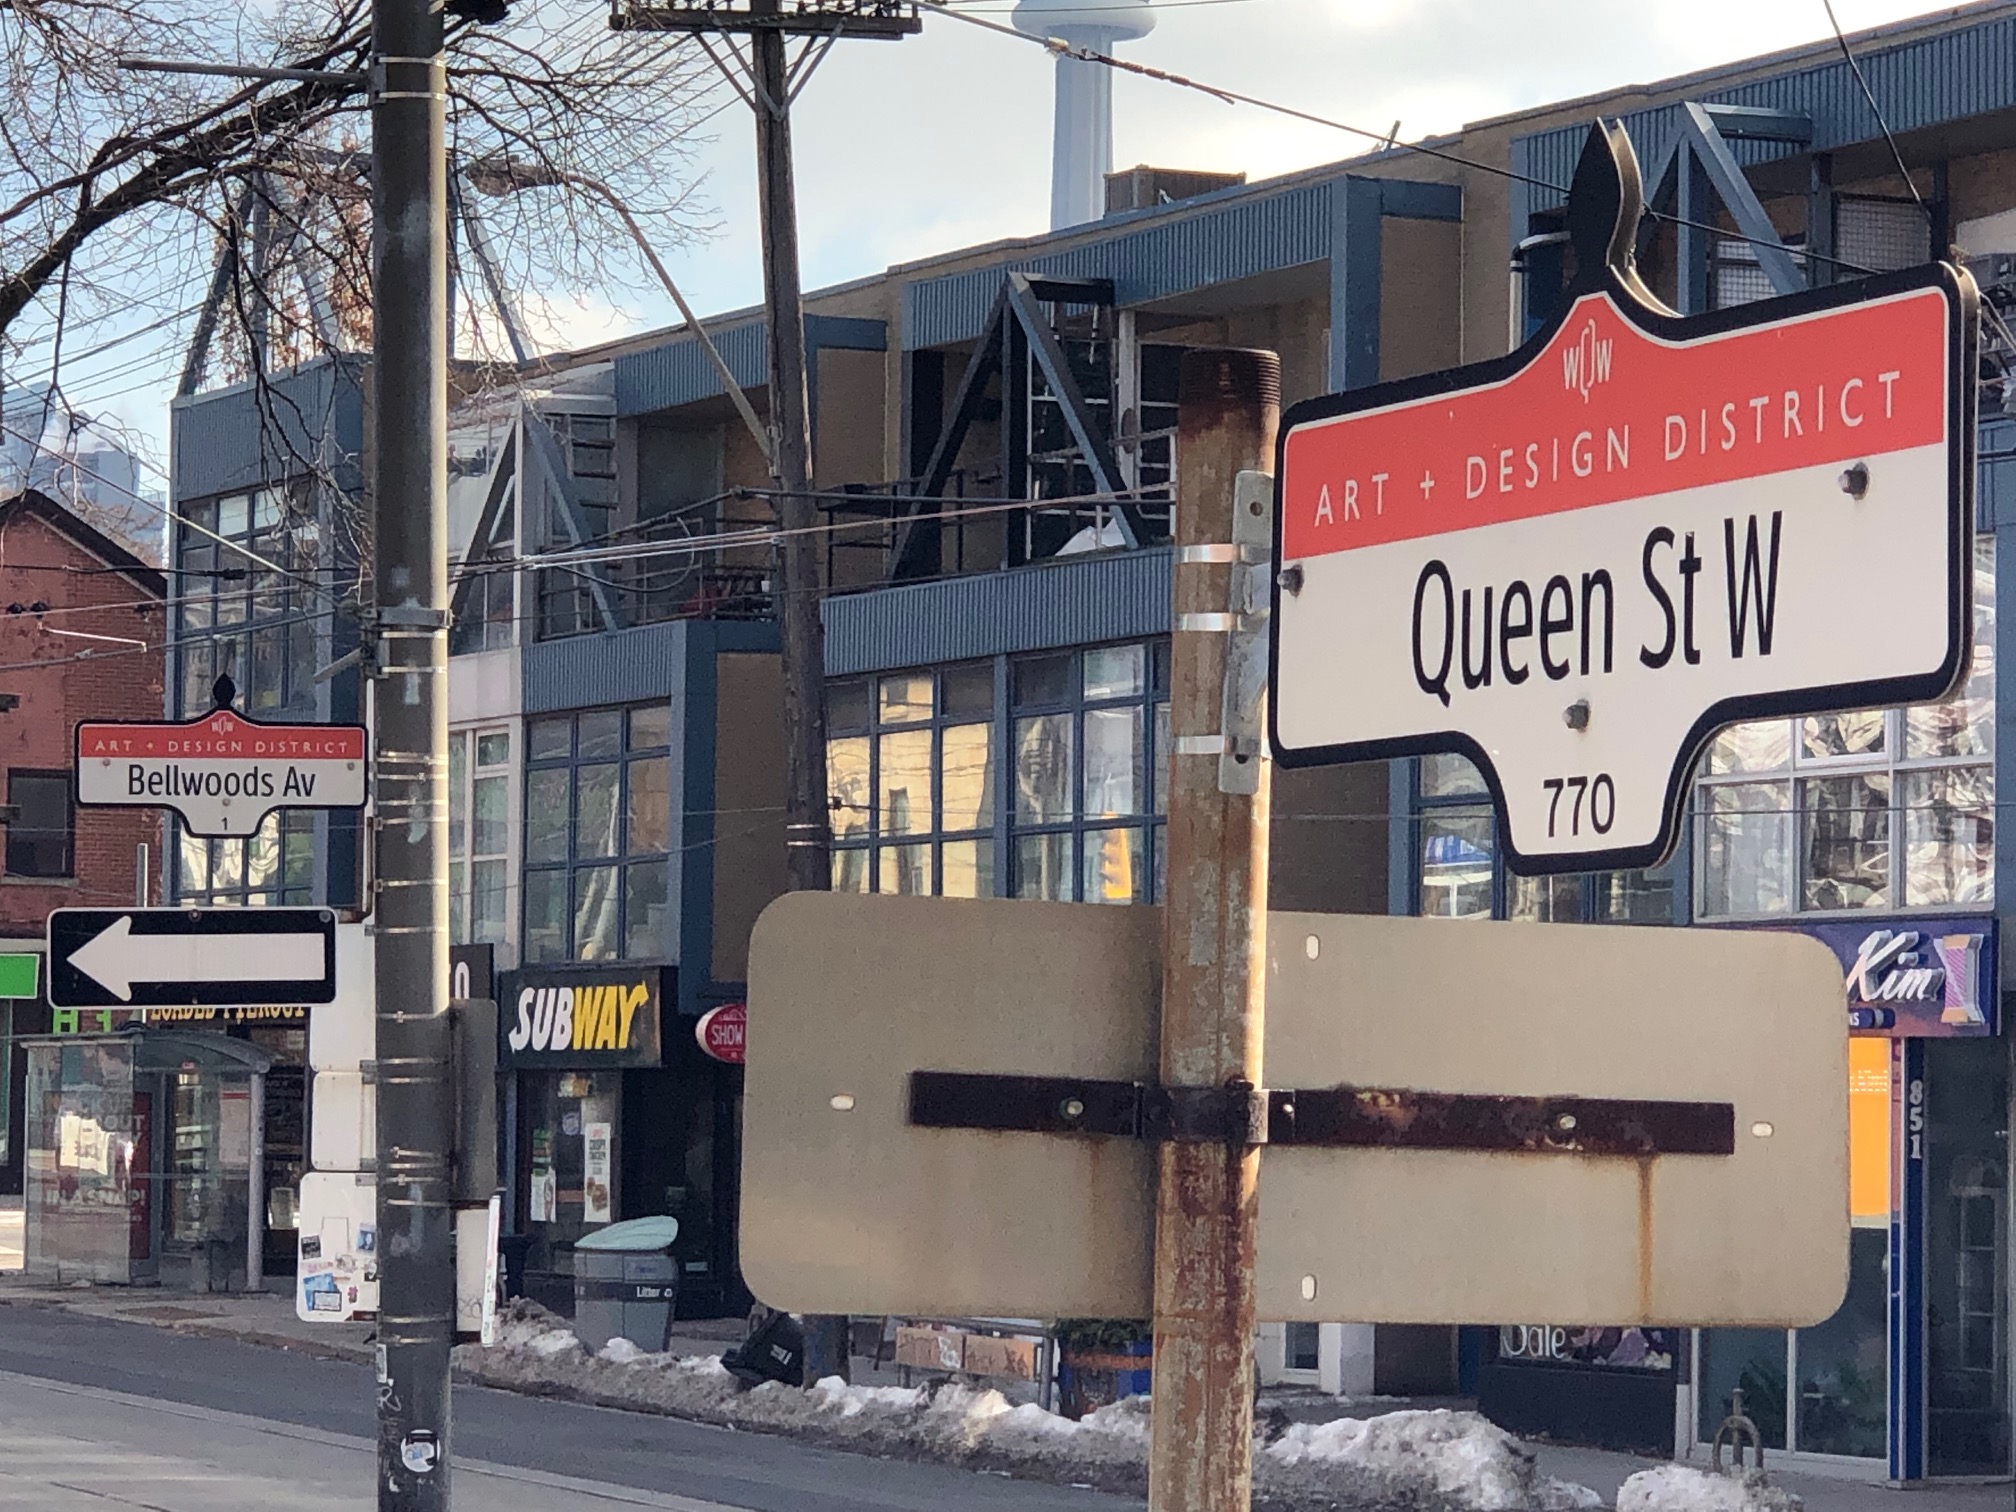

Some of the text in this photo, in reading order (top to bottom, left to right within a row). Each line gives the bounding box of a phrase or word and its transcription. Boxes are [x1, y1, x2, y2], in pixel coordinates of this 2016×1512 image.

[1313, 472, 1389, 527] ART
[1465, 423, 1630, 500] DESIGN
[1664, 370, 1901, 462] DISTRICT
[1411, 510, 1784, 708] Queen St W
[95, 740, 132, 752] ART
[168, 740, 243, 753] DESIGN
[255, 741, 348, 754] DISTRICT
[128, 763, 317, 798] Bellwoods Av
[221, 816, 229, 831] 1
[1542, 773, 1616, 839] 770
[1846, 930, 1944, 1001] Kim
[508, 980, 650, 1053] SUBWAY
[1909, 1080, 1924, 1160] 851
[636, 1286, 661, 1298] Litter
